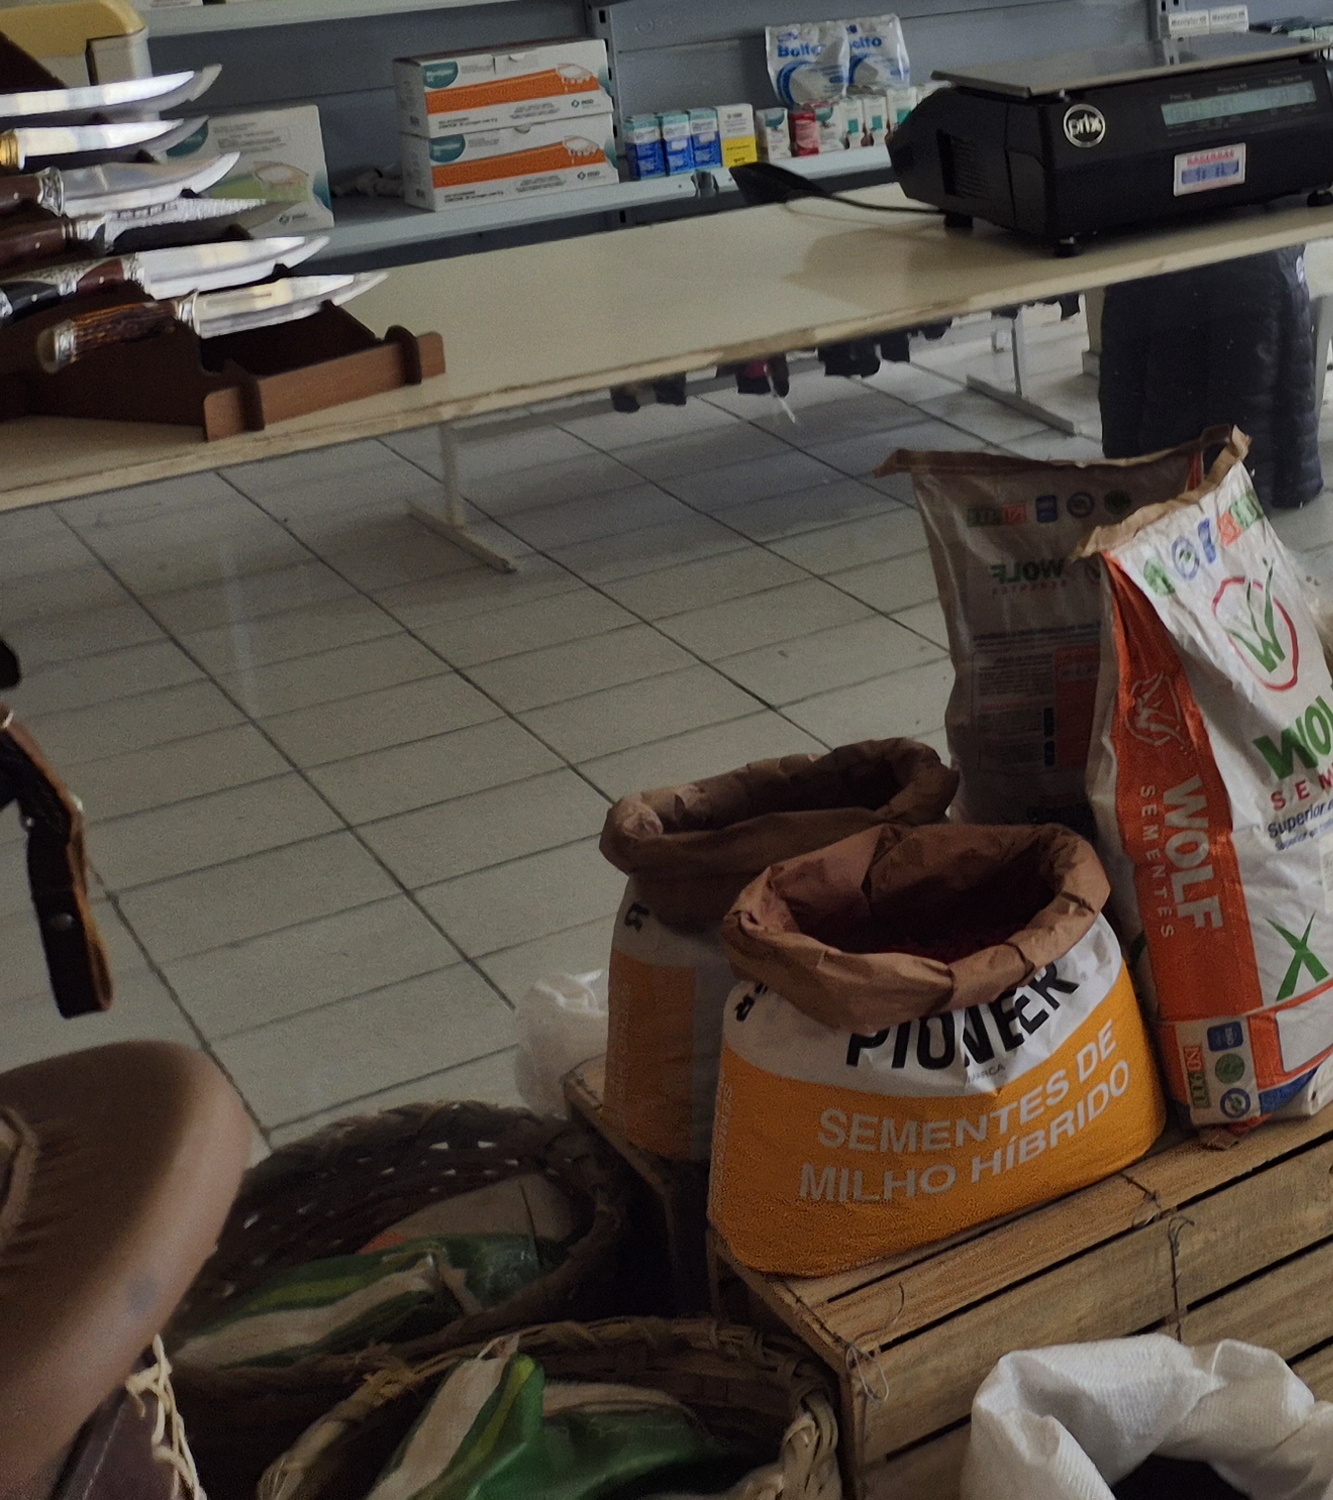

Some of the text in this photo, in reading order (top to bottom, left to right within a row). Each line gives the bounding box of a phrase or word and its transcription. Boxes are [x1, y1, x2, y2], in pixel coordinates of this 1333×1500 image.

[850, 35, 882, 50] olfo
[1140, 785, 1175, 938] SEMENTES
[1163, 775, 1223, 929] WOLF
[1268, 803, 1325, 839] Superior
[800, 1059, 1131, 1203] MILHO HÍBRIDO
[818, 1019, 1119, 1154] SEMENTES DE
